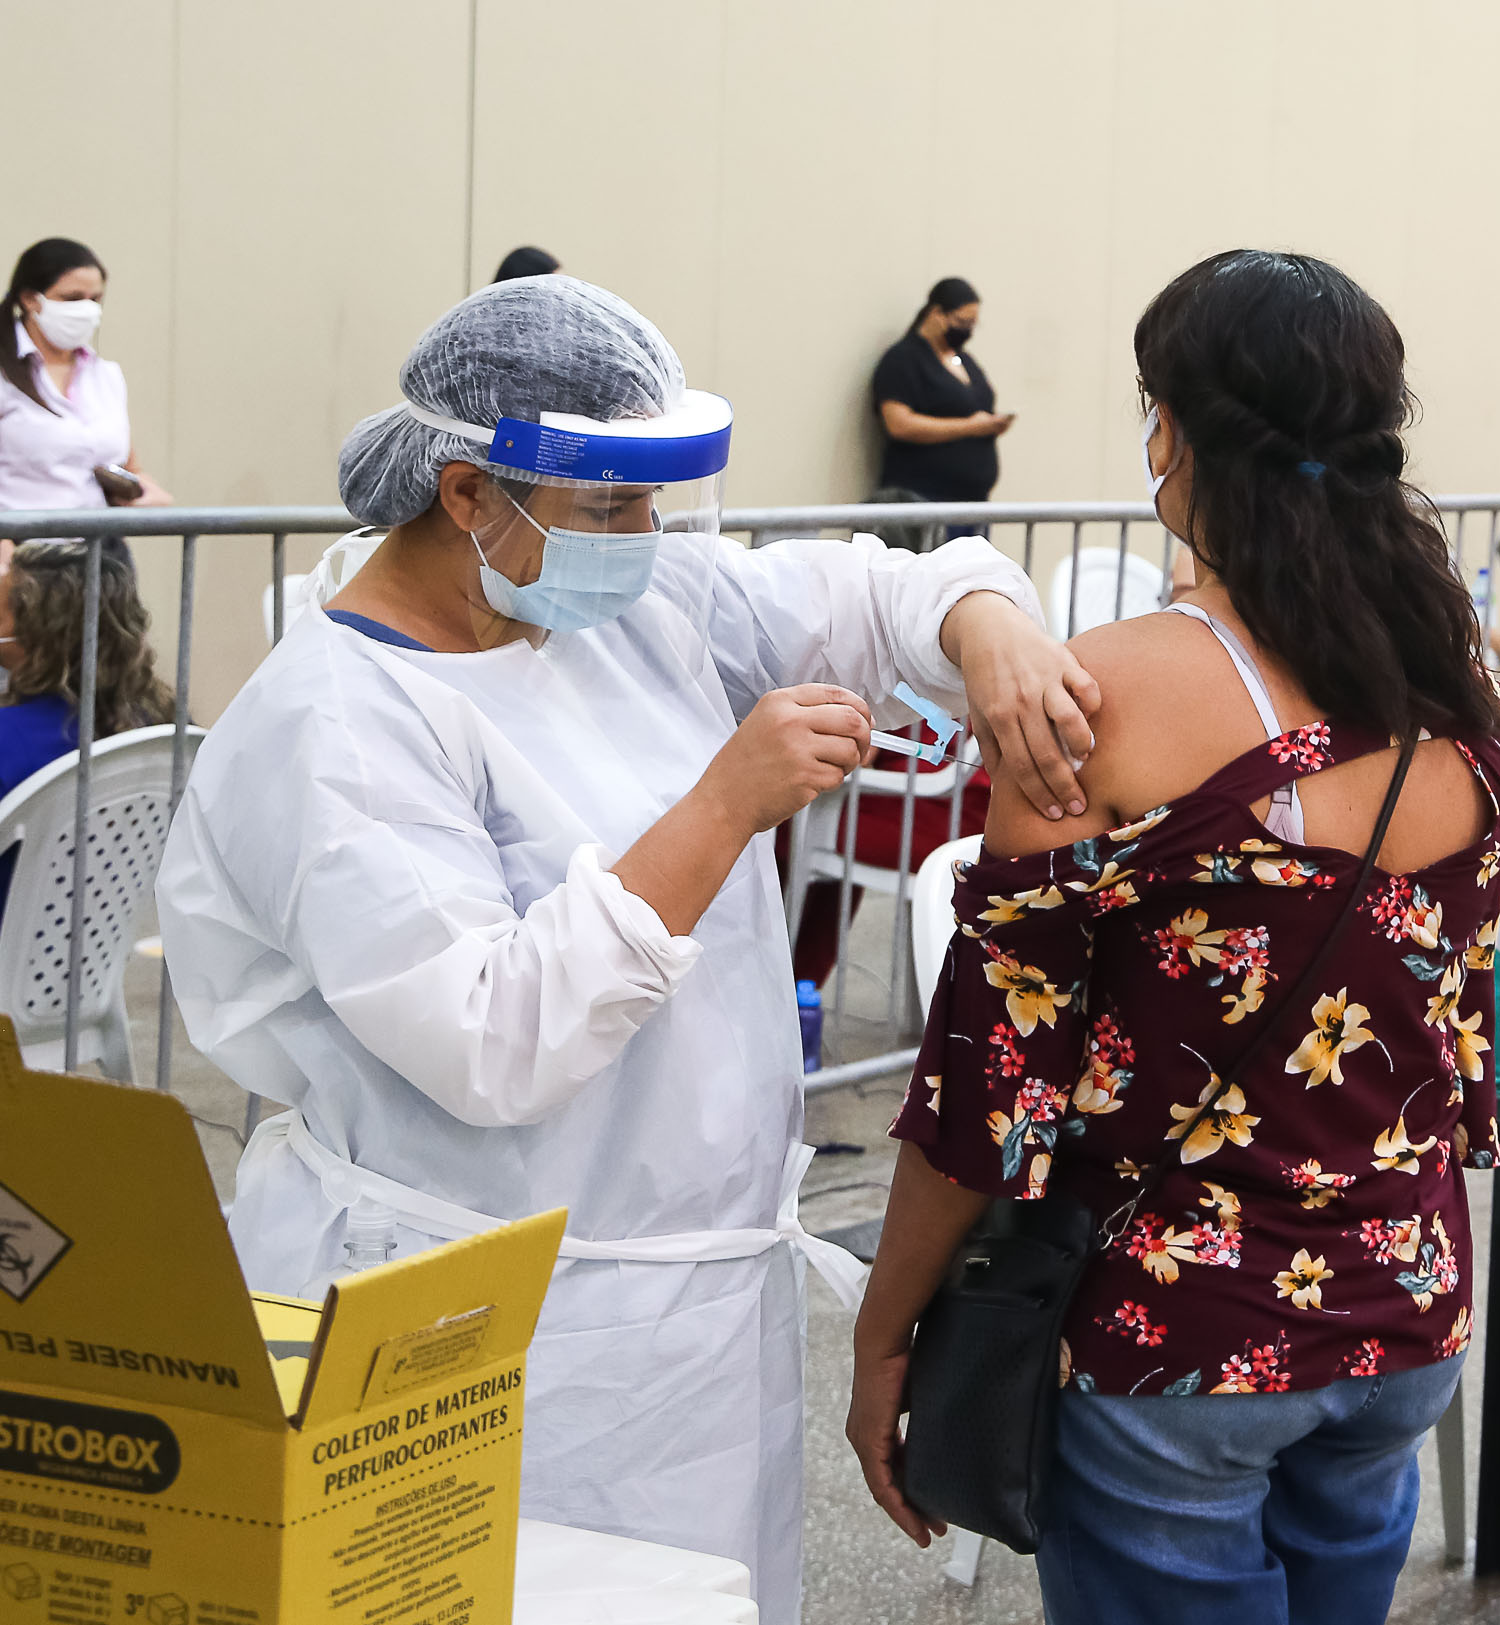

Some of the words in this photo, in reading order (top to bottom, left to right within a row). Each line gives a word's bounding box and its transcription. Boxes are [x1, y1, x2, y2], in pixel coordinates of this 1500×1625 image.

[65, 1340, 240, 1388] MANUSEIE
[313, 1415, 399, 1464] COLETOR
[406, 1403, 429, 1430] DE
[435, 1368, 521, 1419] MATERIAIS
[323, 1405, 508, 1496] PERFUROCORTANTES
[32, 1530, 56, 1551] DE
[59, 1535, 151, 1565] MONTAGEM
